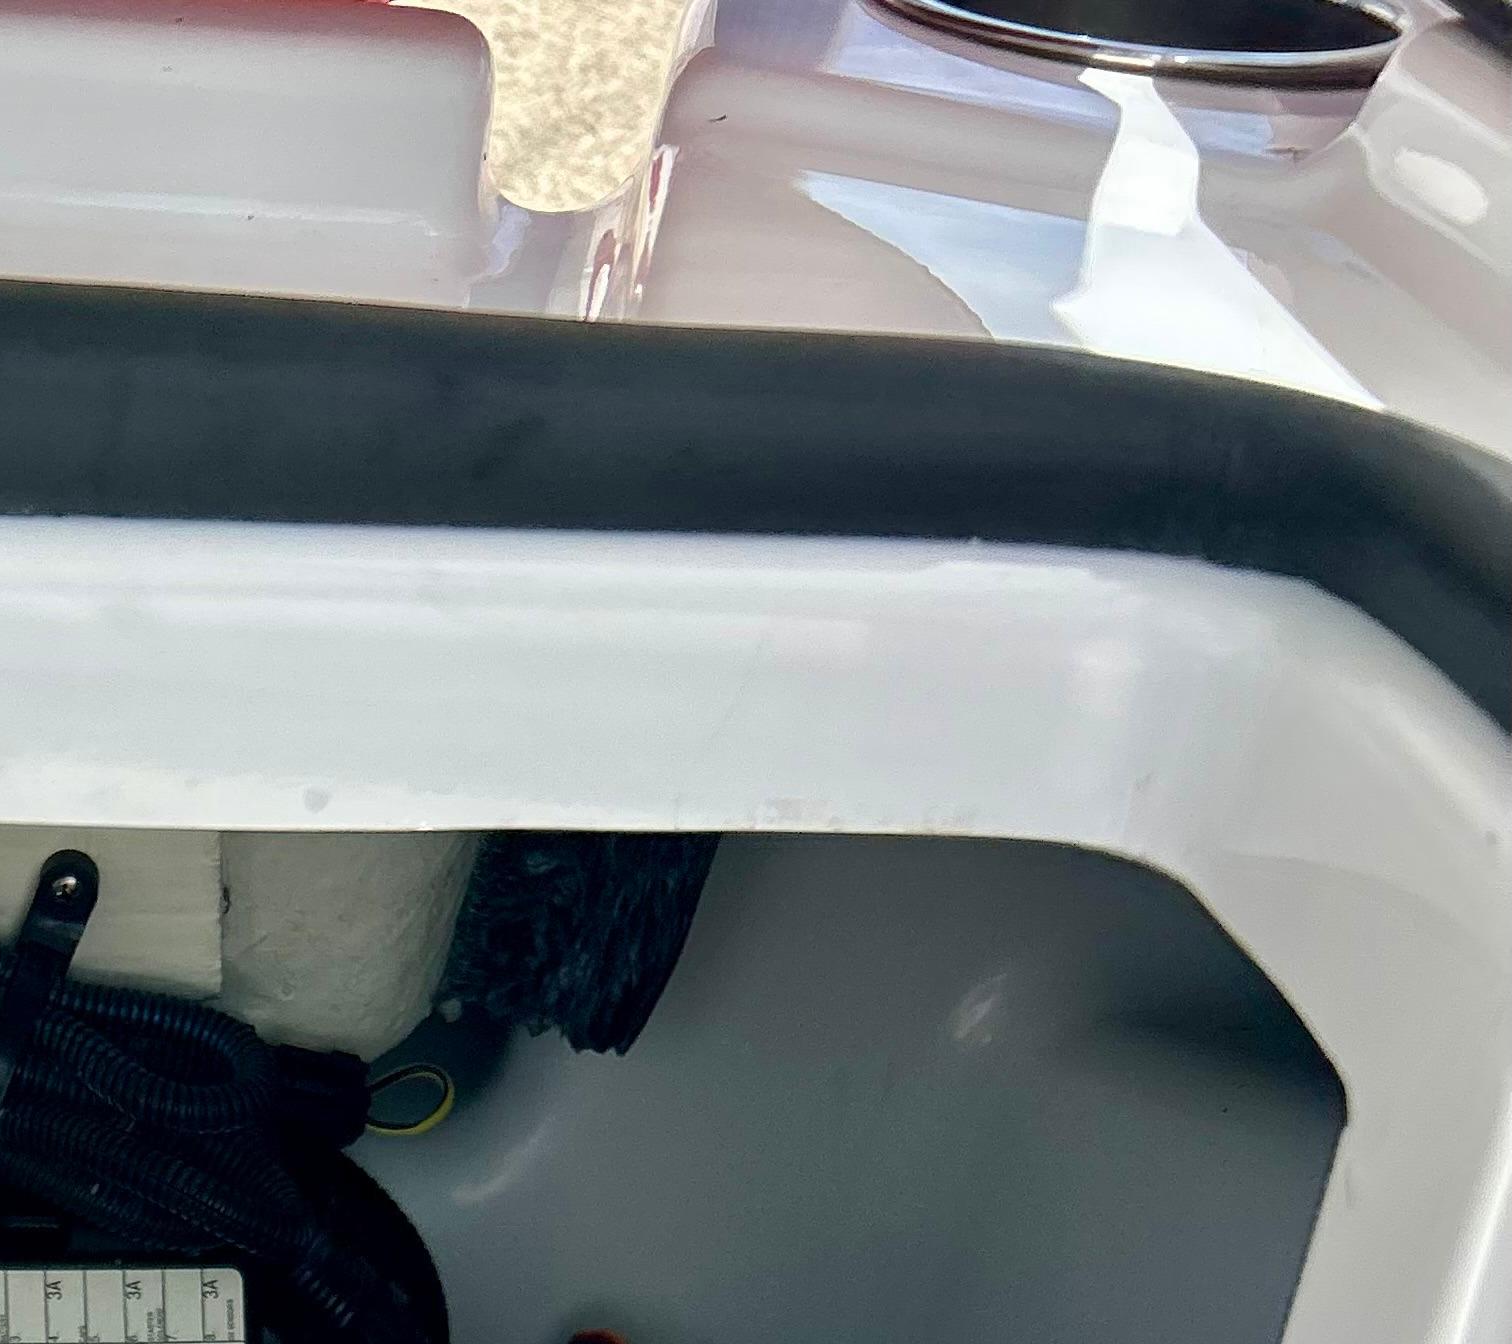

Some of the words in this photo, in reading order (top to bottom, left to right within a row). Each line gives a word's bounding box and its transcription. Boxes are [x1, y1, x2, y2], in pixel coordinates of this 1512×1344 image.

[46, 1280, 63, 1300] 3A
[126, 1280, 142, 1300] 3A
[202, 1280, 220, 1299] 3A
